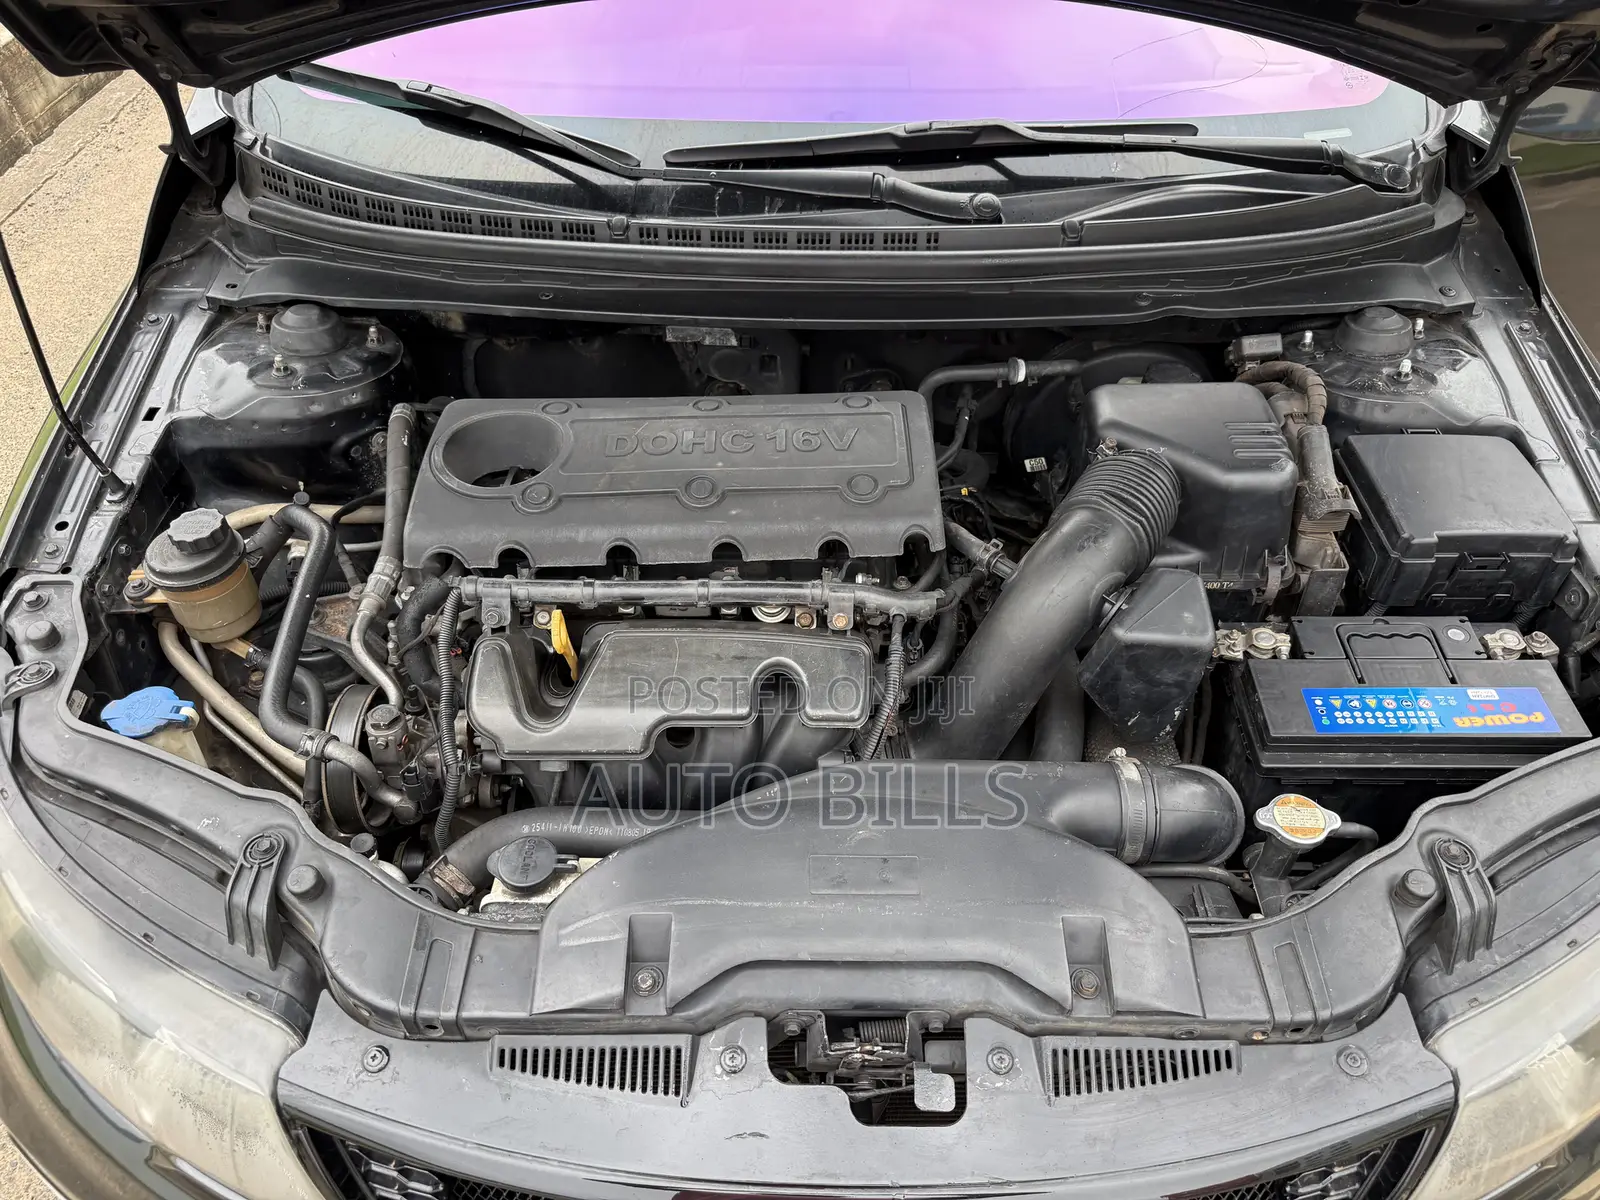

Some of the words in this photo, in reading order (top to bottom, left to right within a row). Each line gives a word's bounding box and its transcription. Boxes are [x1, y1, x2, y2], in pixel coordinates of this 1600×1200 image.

[604, 430, 755, 457] DOHC
[766, 427, 860, 452] 16V
[1455, 711, 1546, 728] POWER
[520, 838, 537, 881] COOLANT
